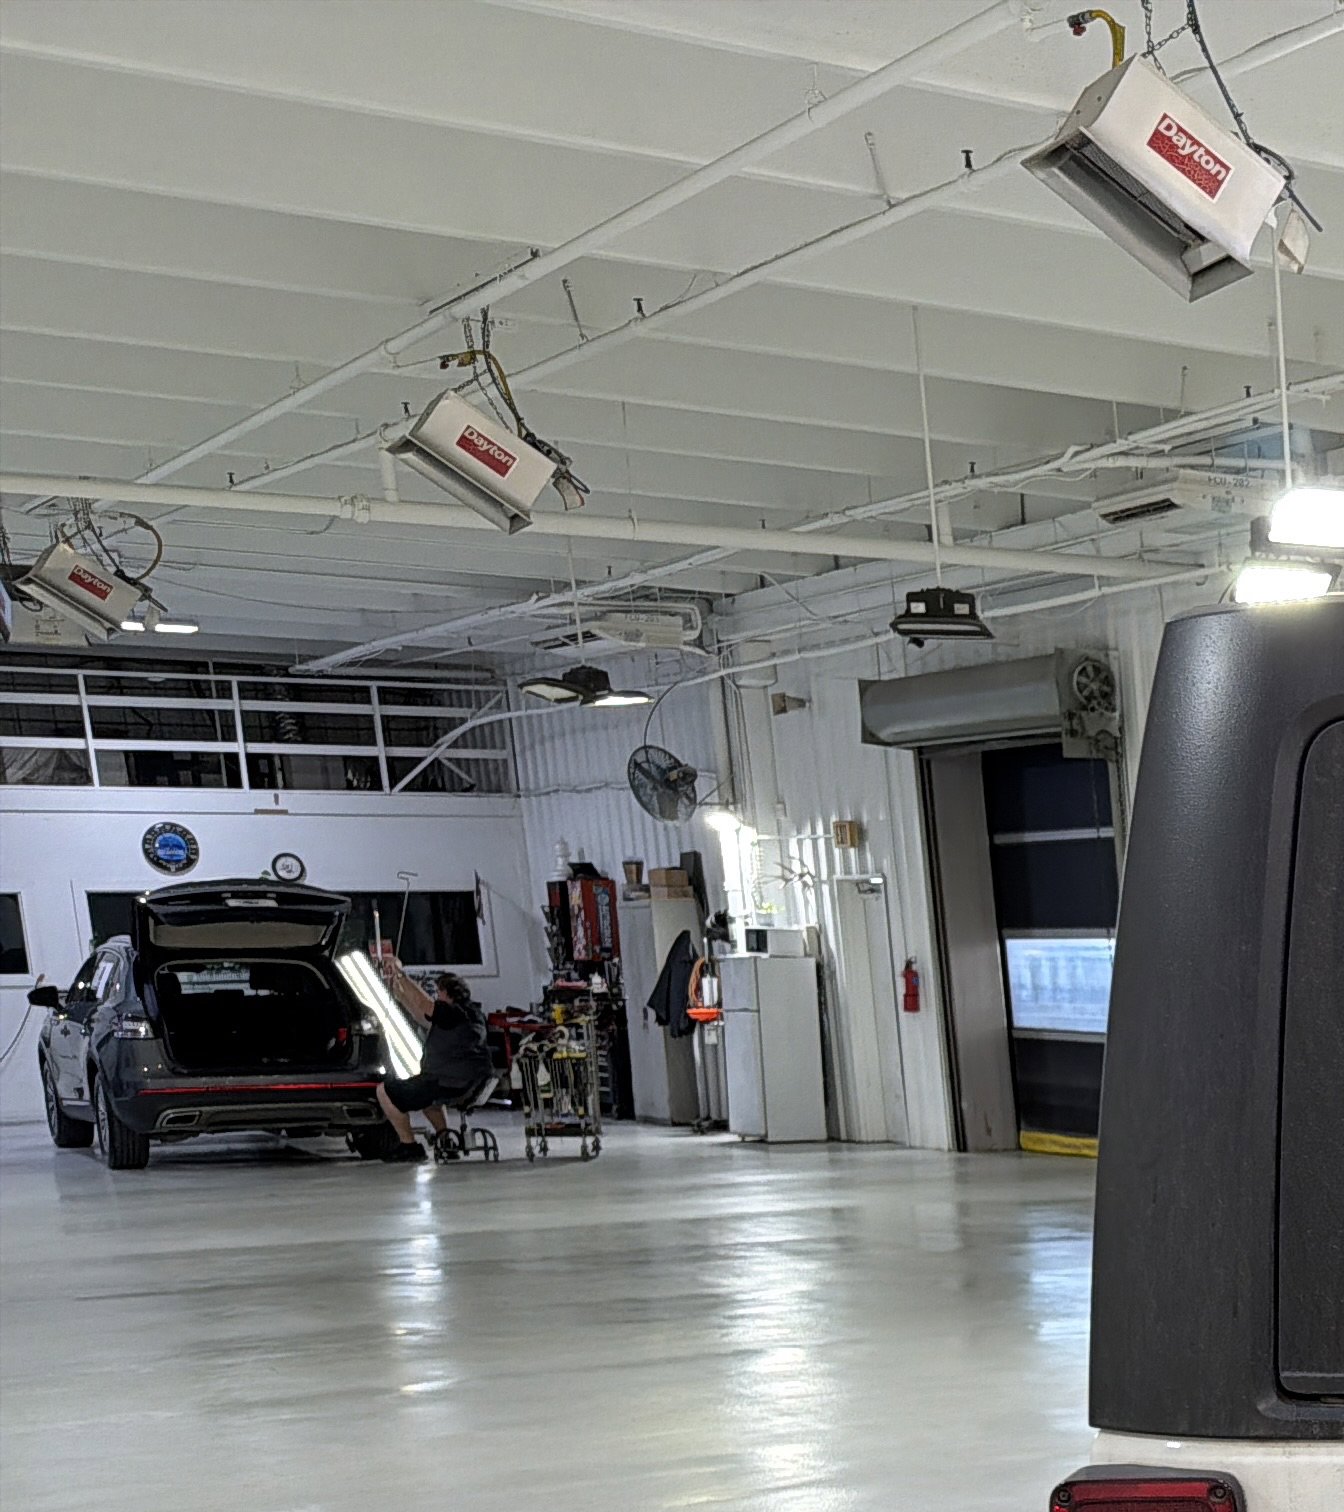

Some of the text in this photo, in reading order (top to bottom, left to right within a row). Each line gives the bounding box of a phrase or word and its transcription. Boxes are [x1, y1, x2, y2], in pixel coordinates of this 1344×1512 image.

[1157, 117, 1227, 181] Dayton
[463, 428, 514, 467] Dayton
[73, 566, 111, 593] Dayton
